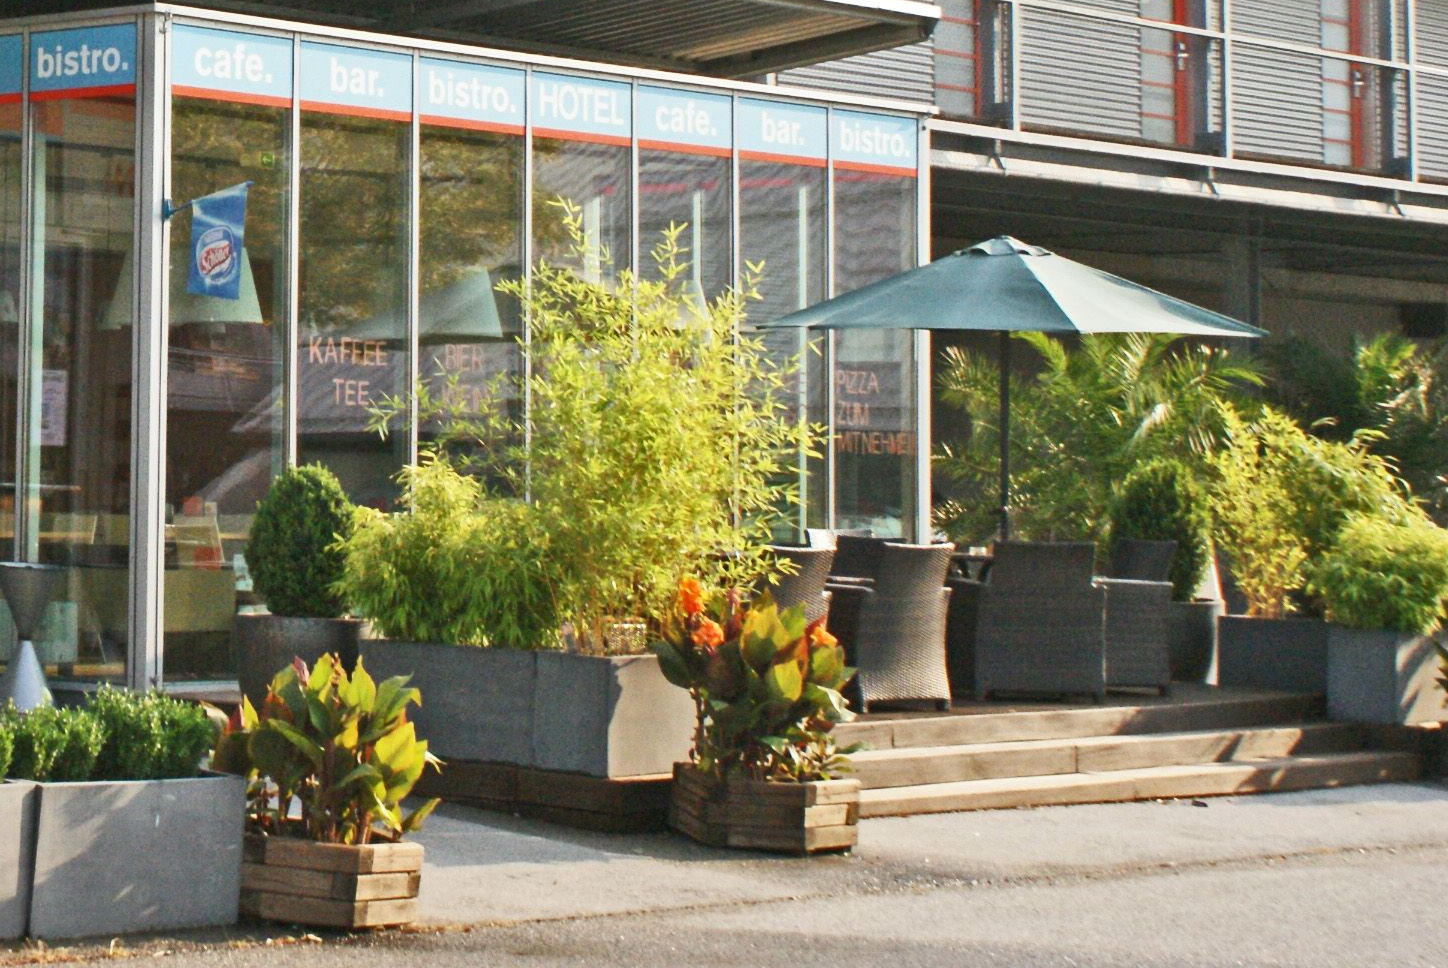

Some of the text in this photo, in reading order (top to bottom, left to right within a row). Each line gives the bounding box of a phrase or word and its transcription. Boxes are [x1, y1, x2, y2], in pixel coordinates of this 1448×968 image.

[36, 43, 129, 78] bistro.
[194, 43, 910, 158] cafe. bar. bistro. HOTEL cafe. bar. bistro.
[308, 336, 388, 367] KAFFEE
[332, 378, 370, 406] TEE
[837, 400, 870, 426] ZUM
